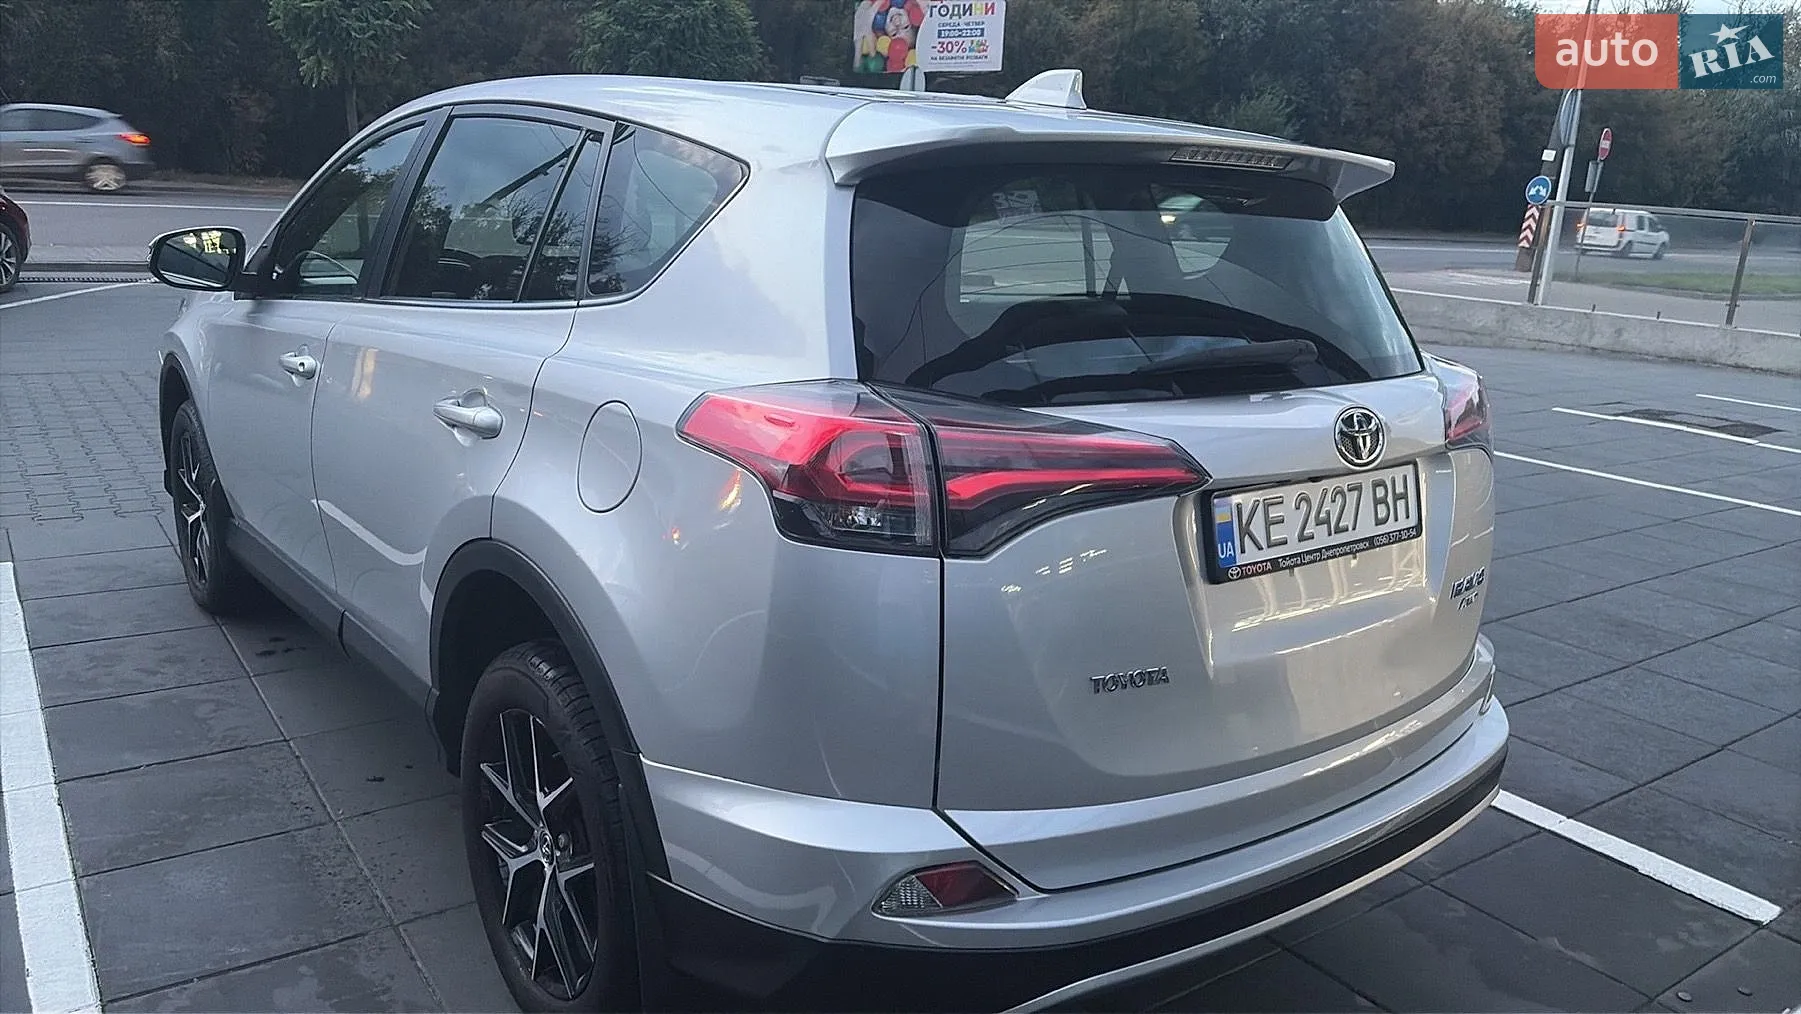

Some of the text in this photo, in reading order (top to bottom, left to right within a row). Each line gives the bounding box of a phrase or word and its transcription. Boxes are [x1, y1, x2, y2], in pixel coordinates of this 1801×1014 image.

[929, 2, 995, 19] ГОДИНИ
[931, 40, 967, 53] -30%
[1235, 473, 1410, 554] KE 2427 BH
[1217, 542, 1235, 559] UA
[1278, 556, 1300, 568] Тойота
[1300, 551, 1321, 564] Центр
[1241, 561, 1272, 576] TOYOTA
[1089, 666, 1169, 694] TOYOTA
